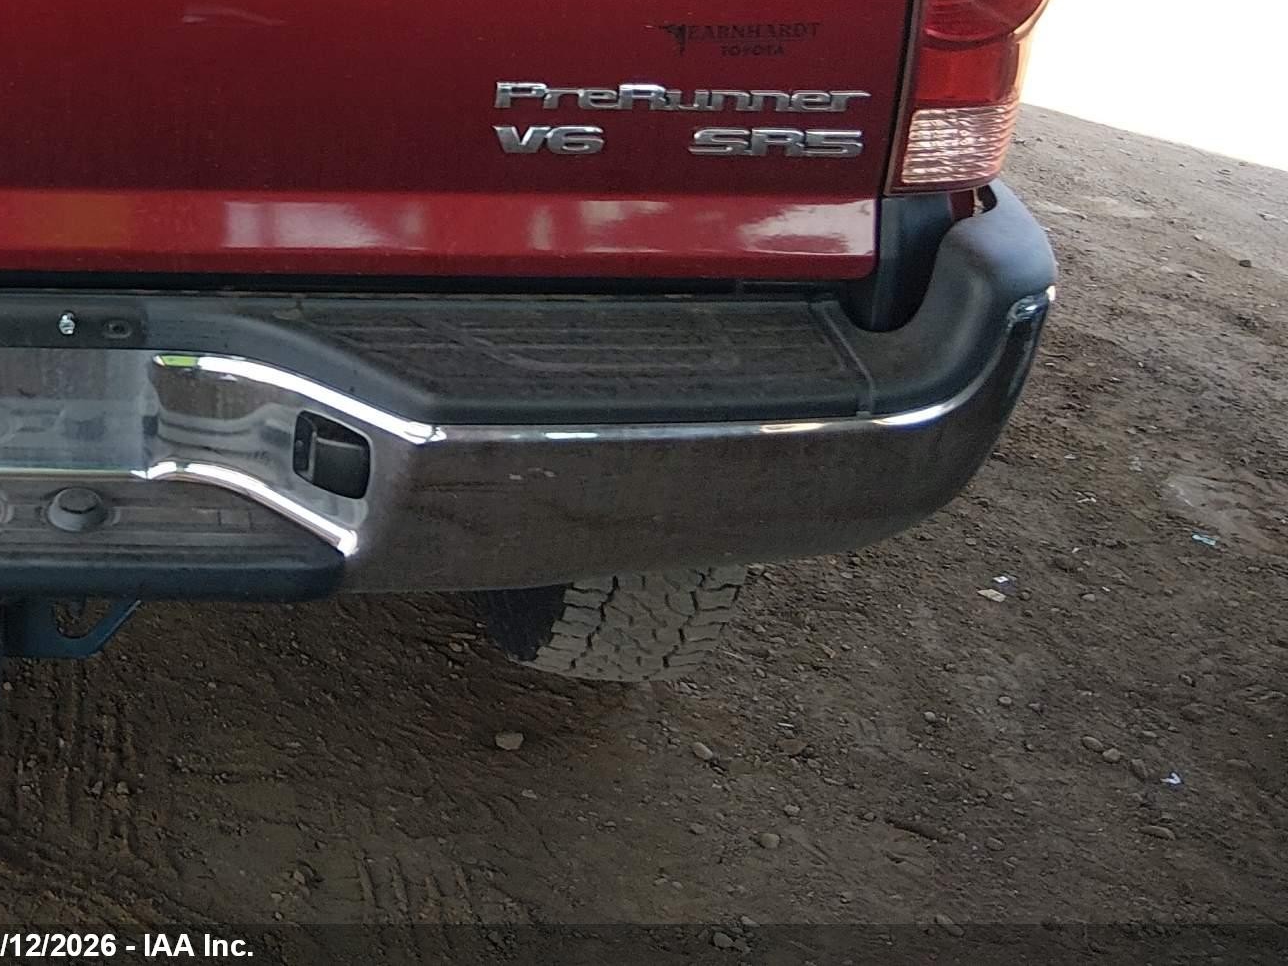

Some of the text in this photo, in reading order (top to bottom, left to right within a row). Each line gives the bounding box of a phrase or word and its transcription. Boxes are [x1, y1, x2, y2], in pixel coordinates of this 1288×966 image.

[720, 44, 785, 57] TOYOTA
[493, 81, 872, 113] PreRunner
[493, 125, 865, 158] V6 SR5
